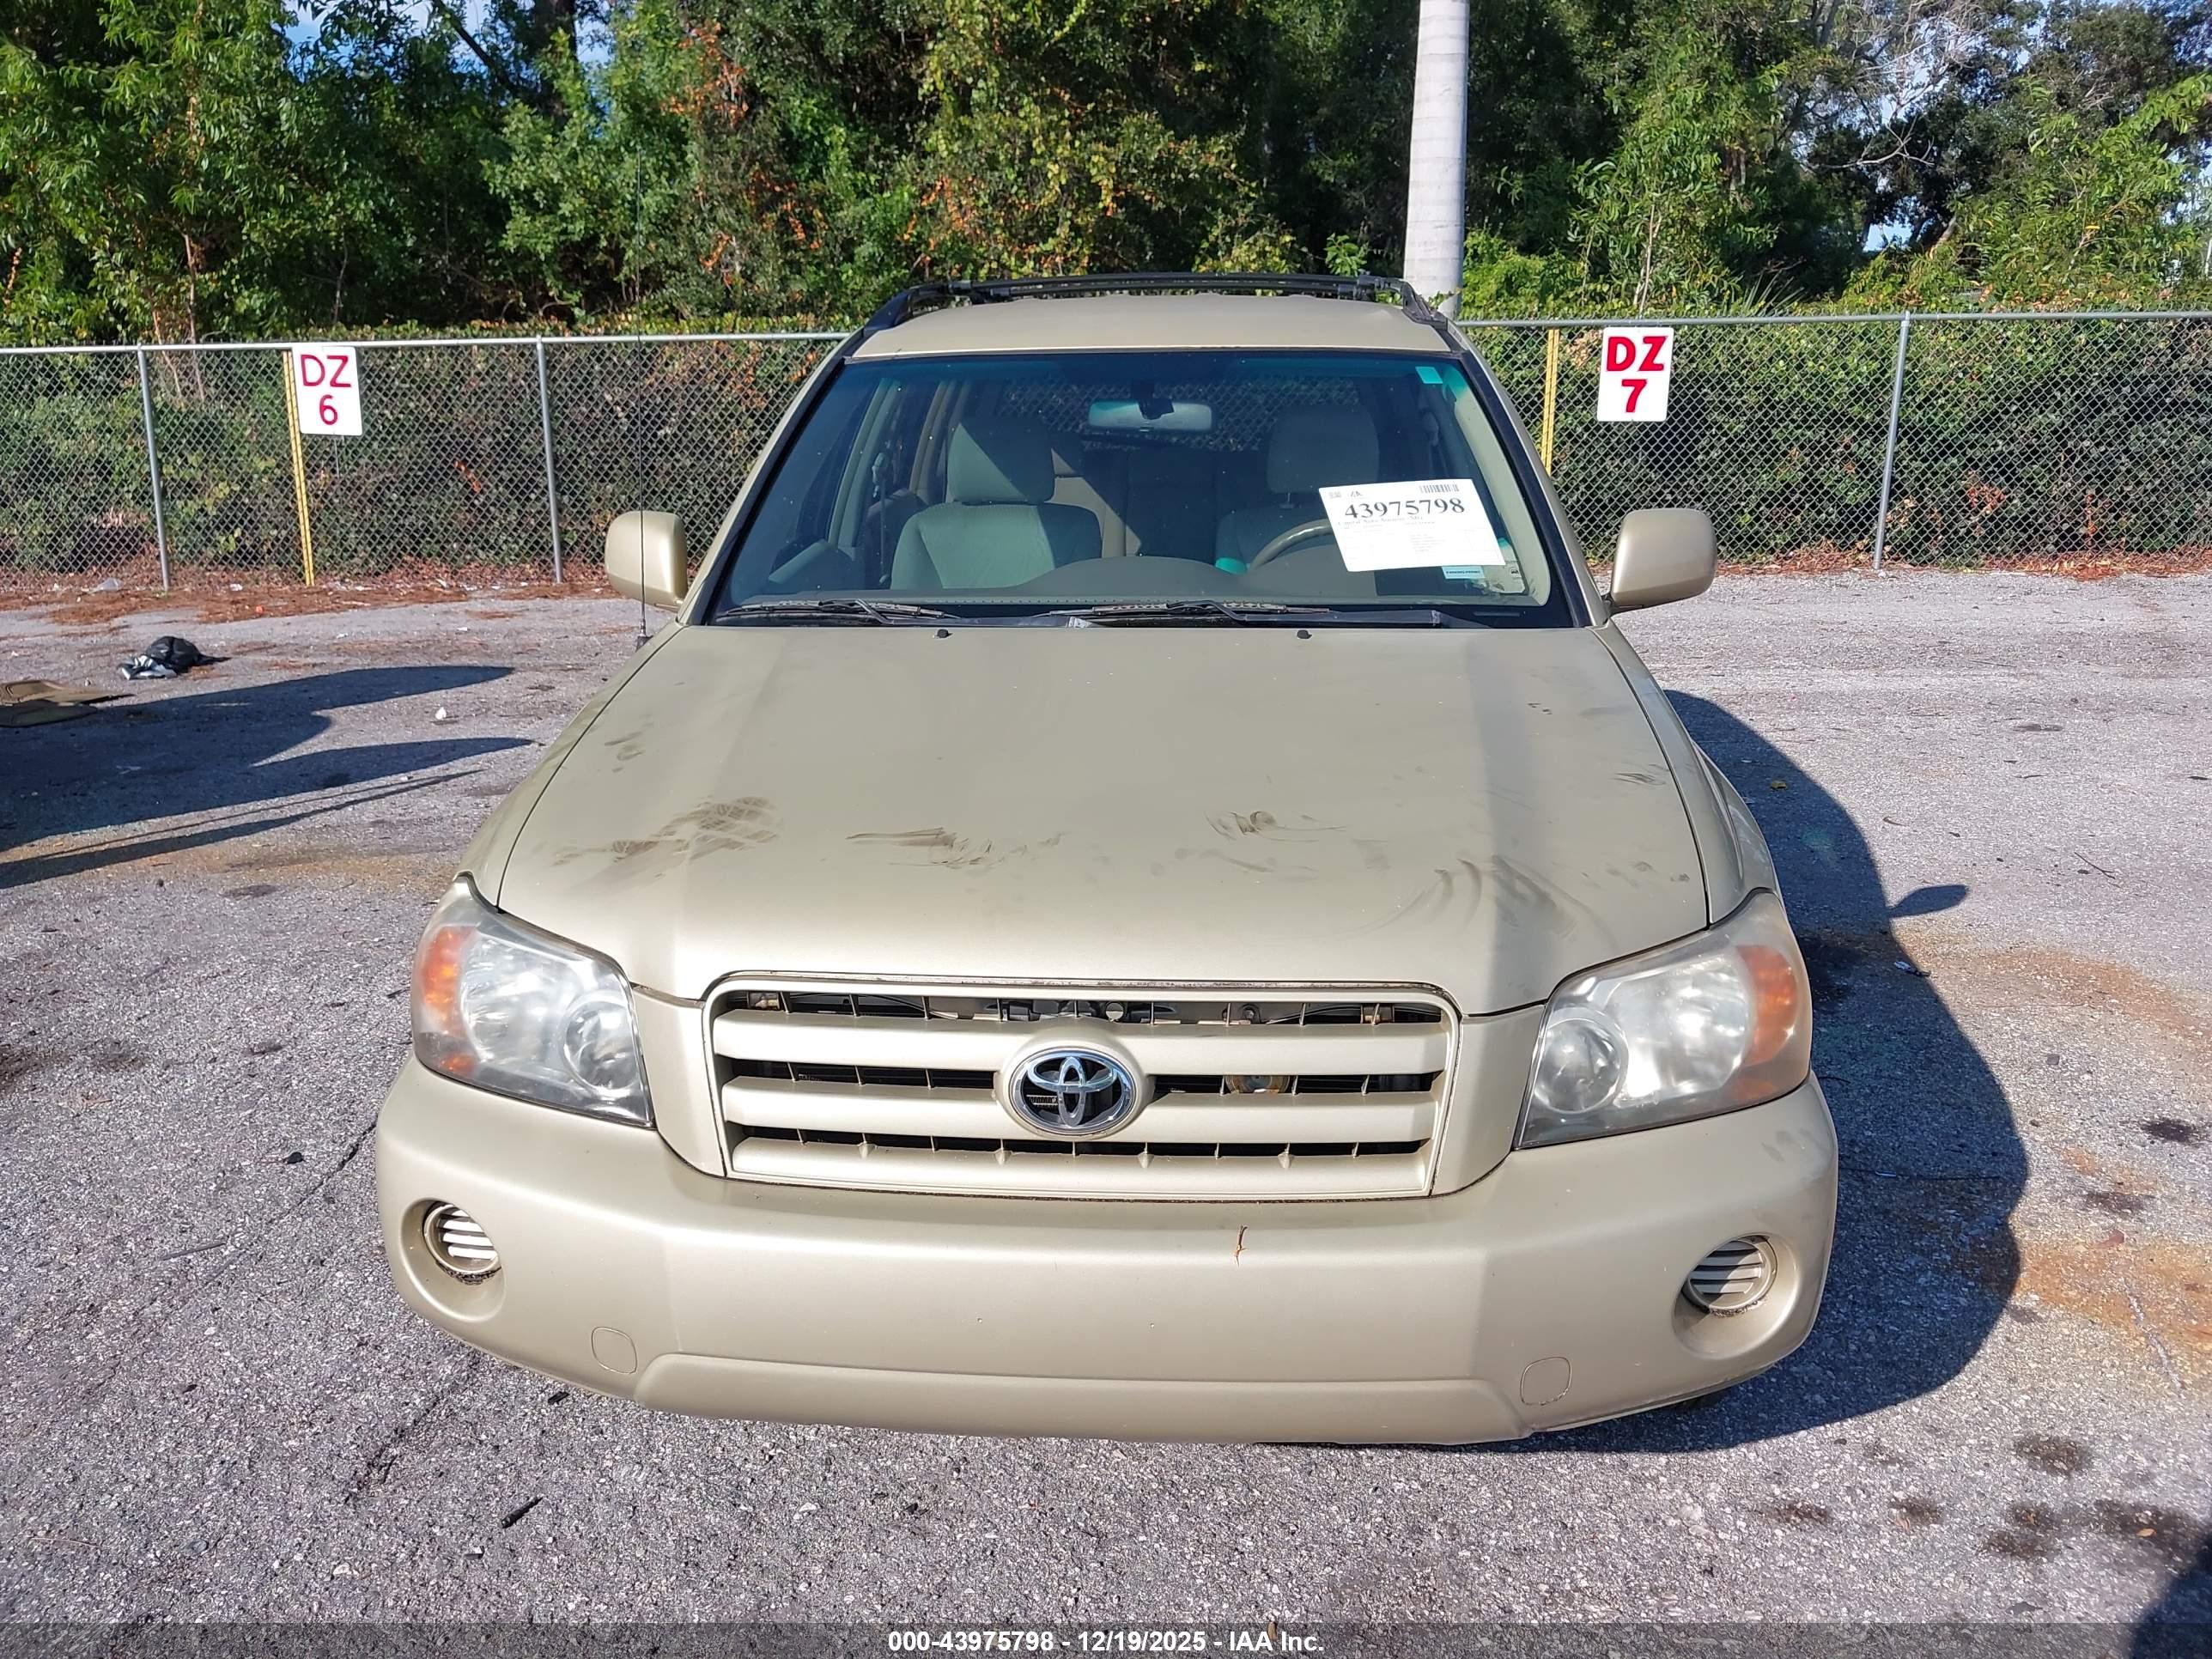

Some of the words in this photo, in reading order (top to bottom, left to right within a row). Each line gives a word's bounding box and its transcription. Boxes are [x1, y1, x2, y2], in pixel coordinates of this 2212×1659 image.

[1606, 335, 1668, 372] DZ
[301, 354, 351, 387] DZ
[319, 394, 337, 425] 6
[1621, 379, 1648, 413] 7
[1344, 497, 1465, 519] 43975798
